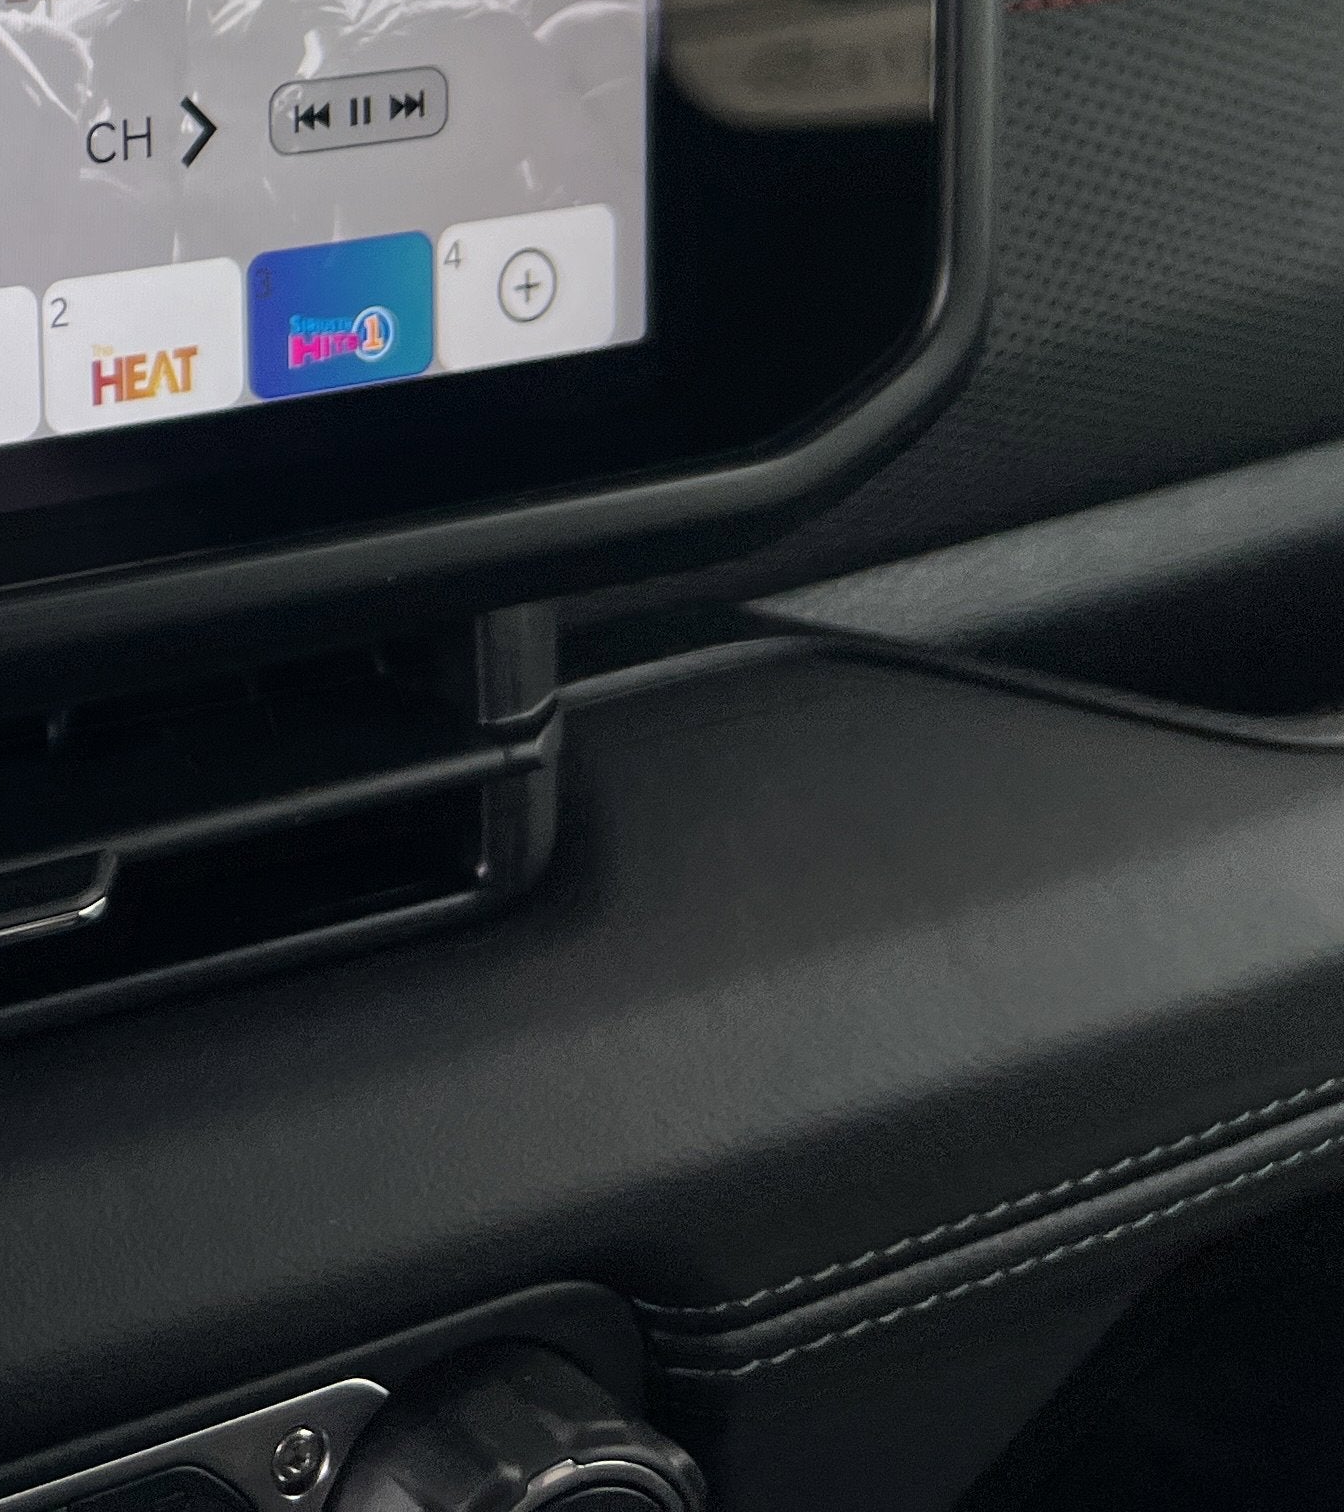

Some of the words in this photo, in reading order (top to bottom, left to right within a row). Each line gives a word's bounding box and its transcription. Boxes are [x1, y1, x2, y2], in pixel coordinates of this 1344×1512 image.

[85, 116, 153, 165] CH
[444, 240, 463, 270] 4
[50, 297, 70, 329] 2
[91, 345, 199, 407] HEAT
